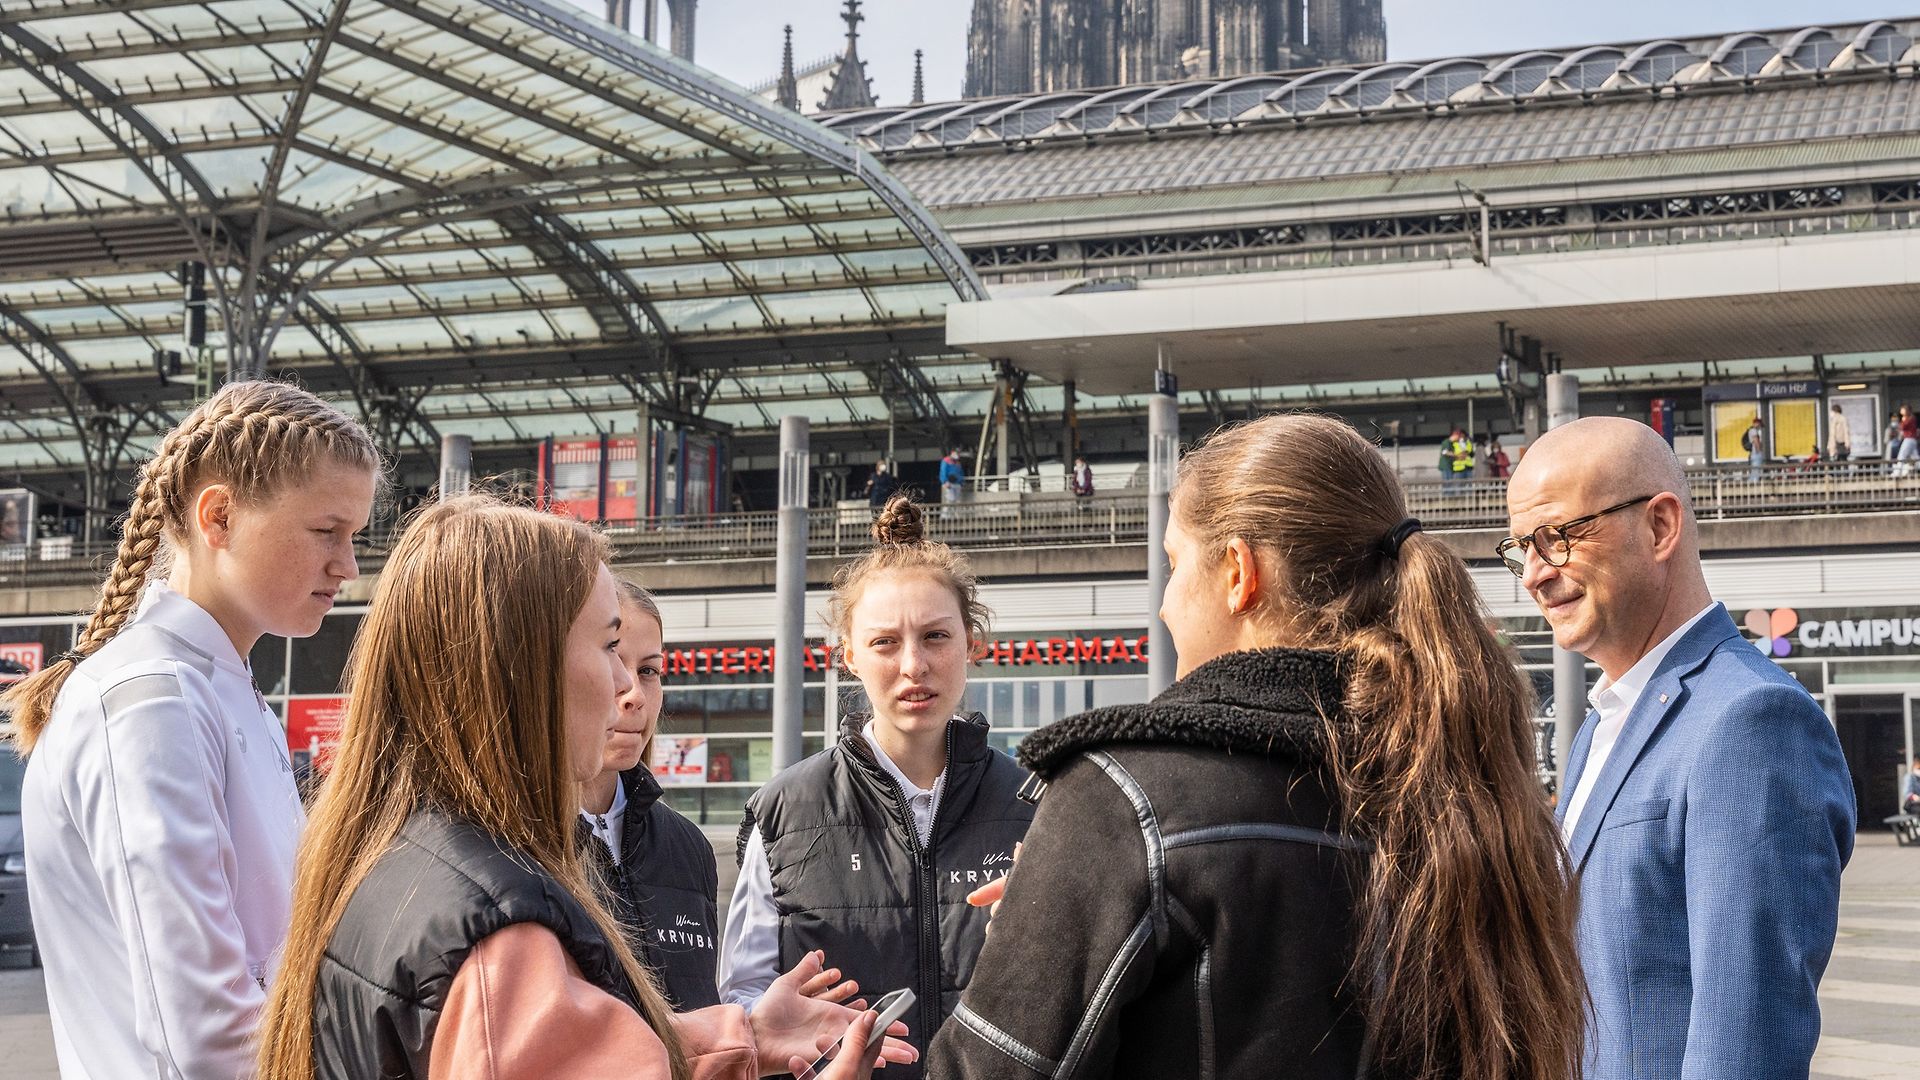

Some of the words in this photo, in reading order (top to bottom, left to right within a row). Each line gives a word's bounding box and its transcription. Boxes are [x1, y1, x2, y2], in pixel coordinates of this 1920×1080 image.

[1764, 384, 1787, 394] Köln
[1789, 382, 1808, 393] Hbf
[972, 635, 1149, 666] PHARMAC
[851, 854, 861, 870] 5
[950, 868, 1009, 883] KRYV
